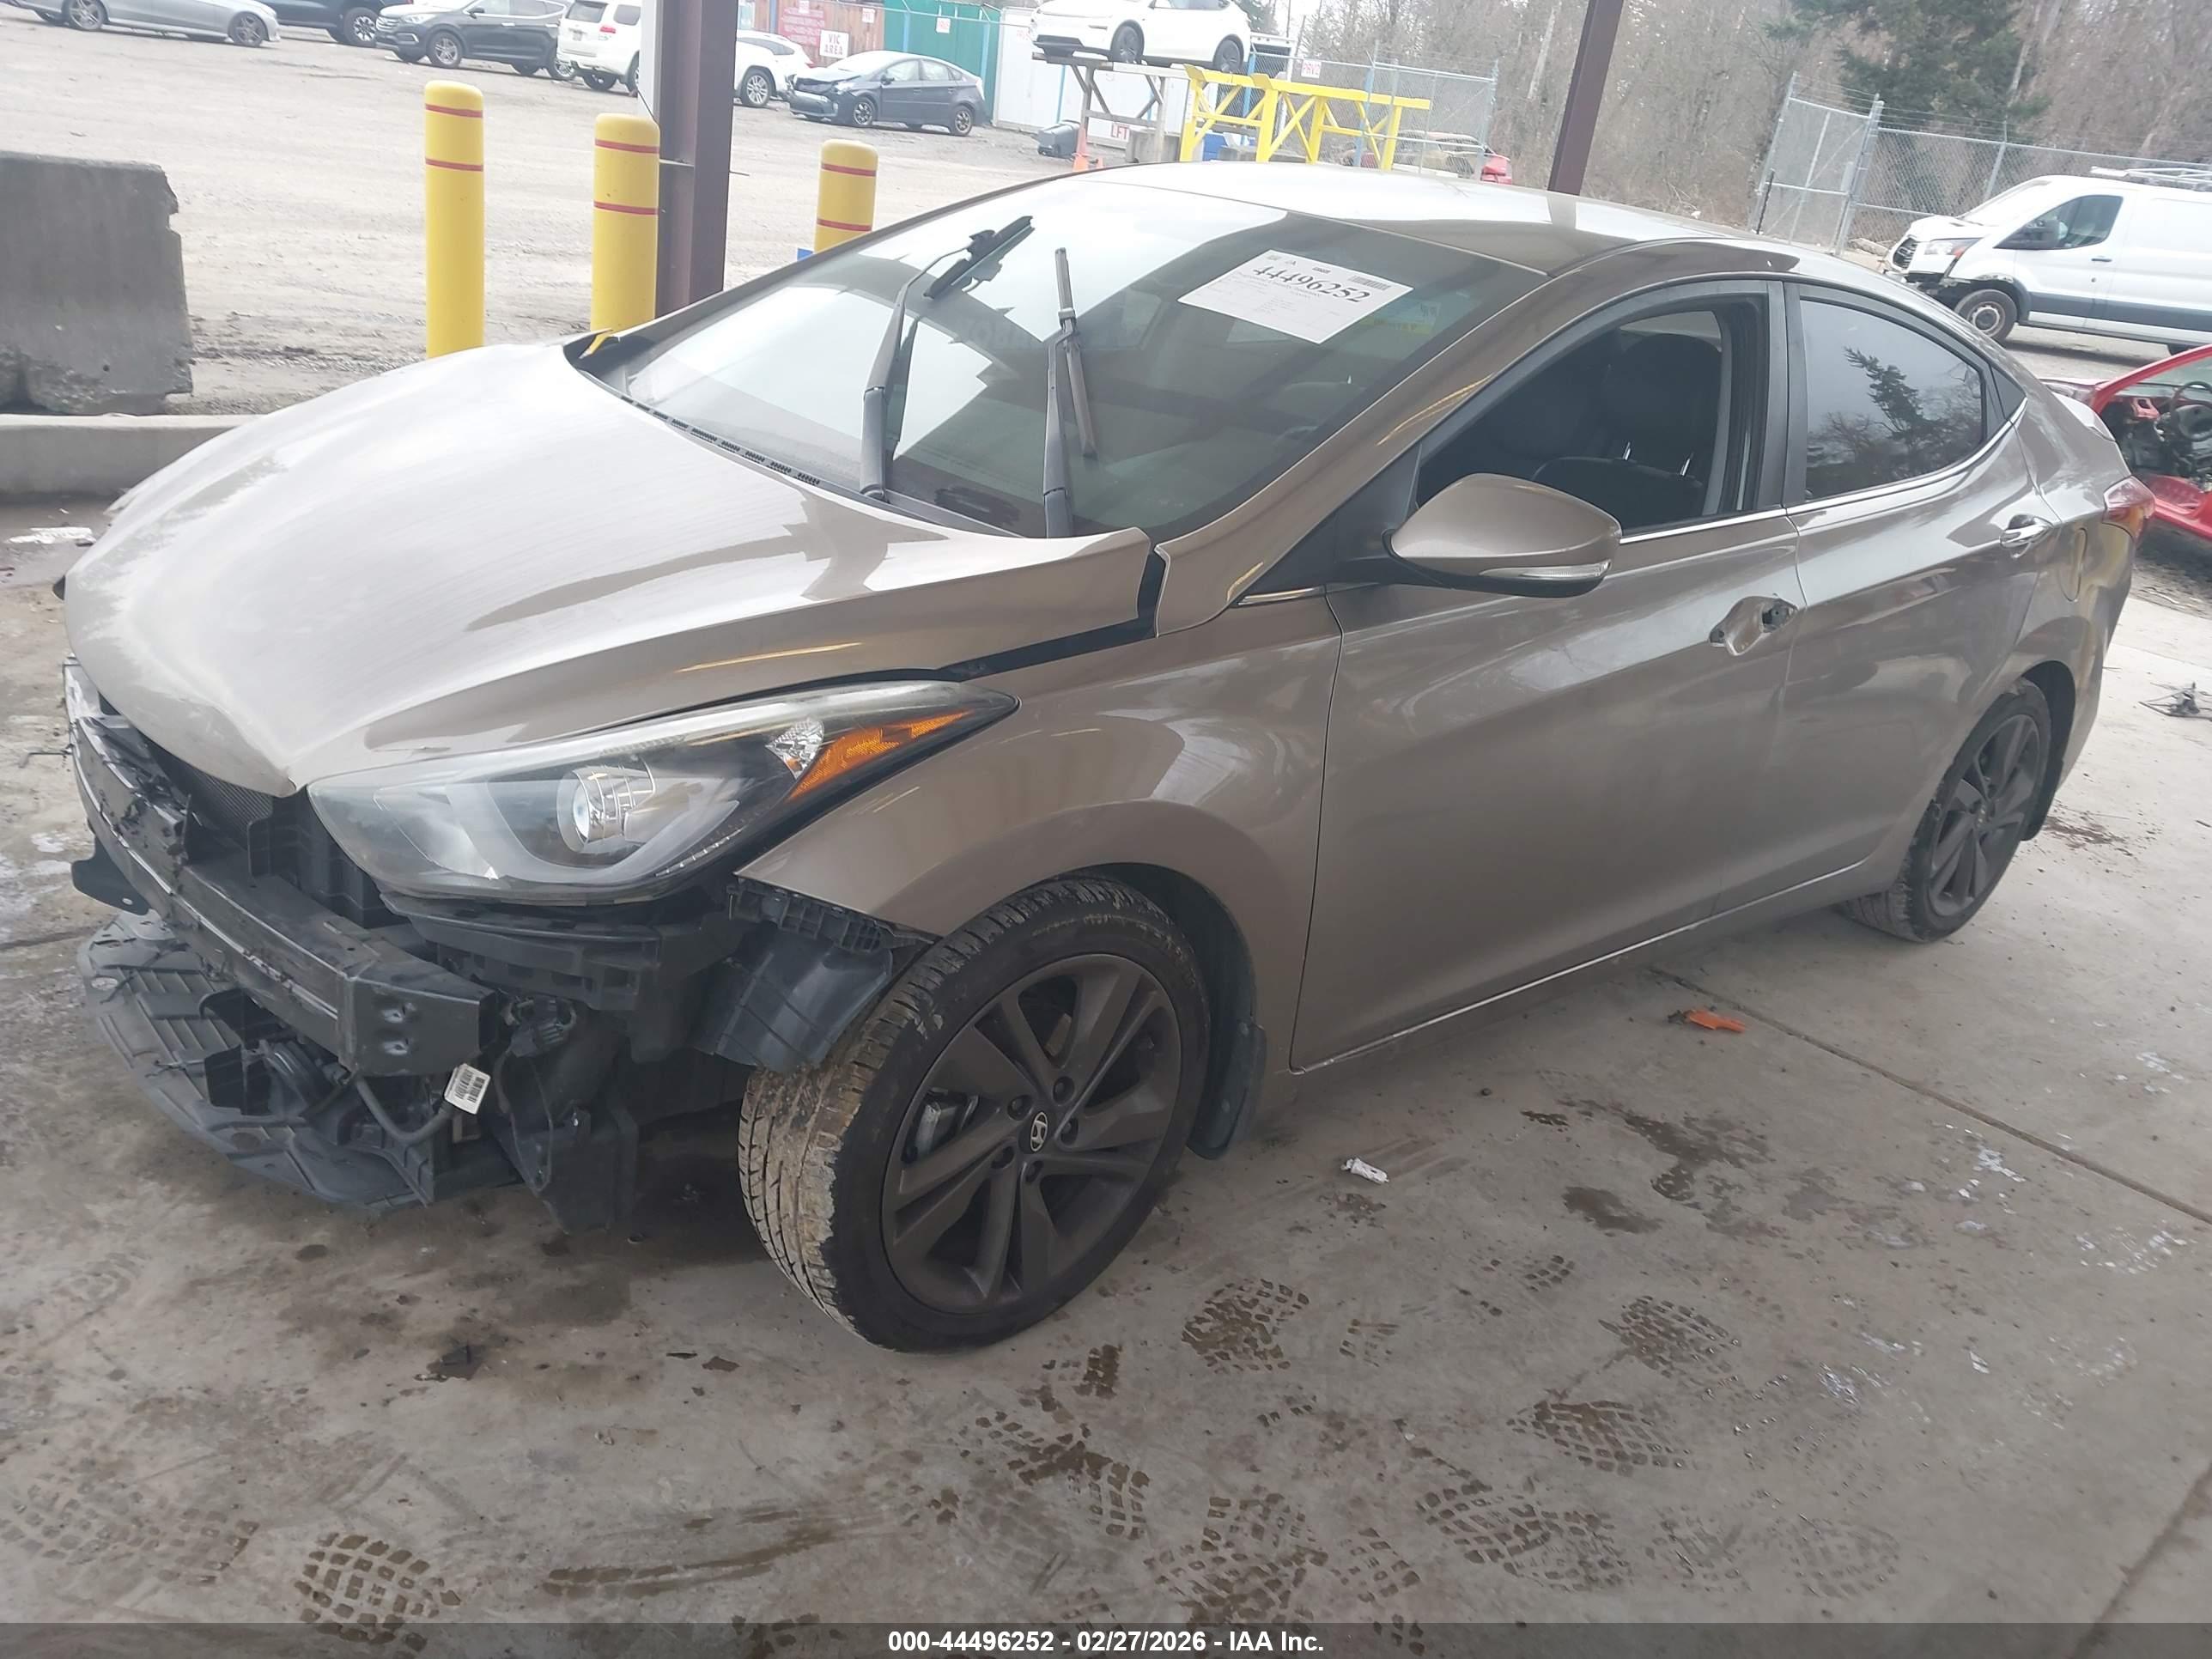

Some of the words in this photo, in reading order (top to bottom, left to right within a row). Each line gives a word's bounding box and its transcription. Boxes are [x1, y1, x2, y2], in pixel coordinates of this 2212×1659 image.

[828, 33, 841, 45] VIC
[823, 44, 843, 55] AREA
[1252, 265, 1371, 303] 44496252
